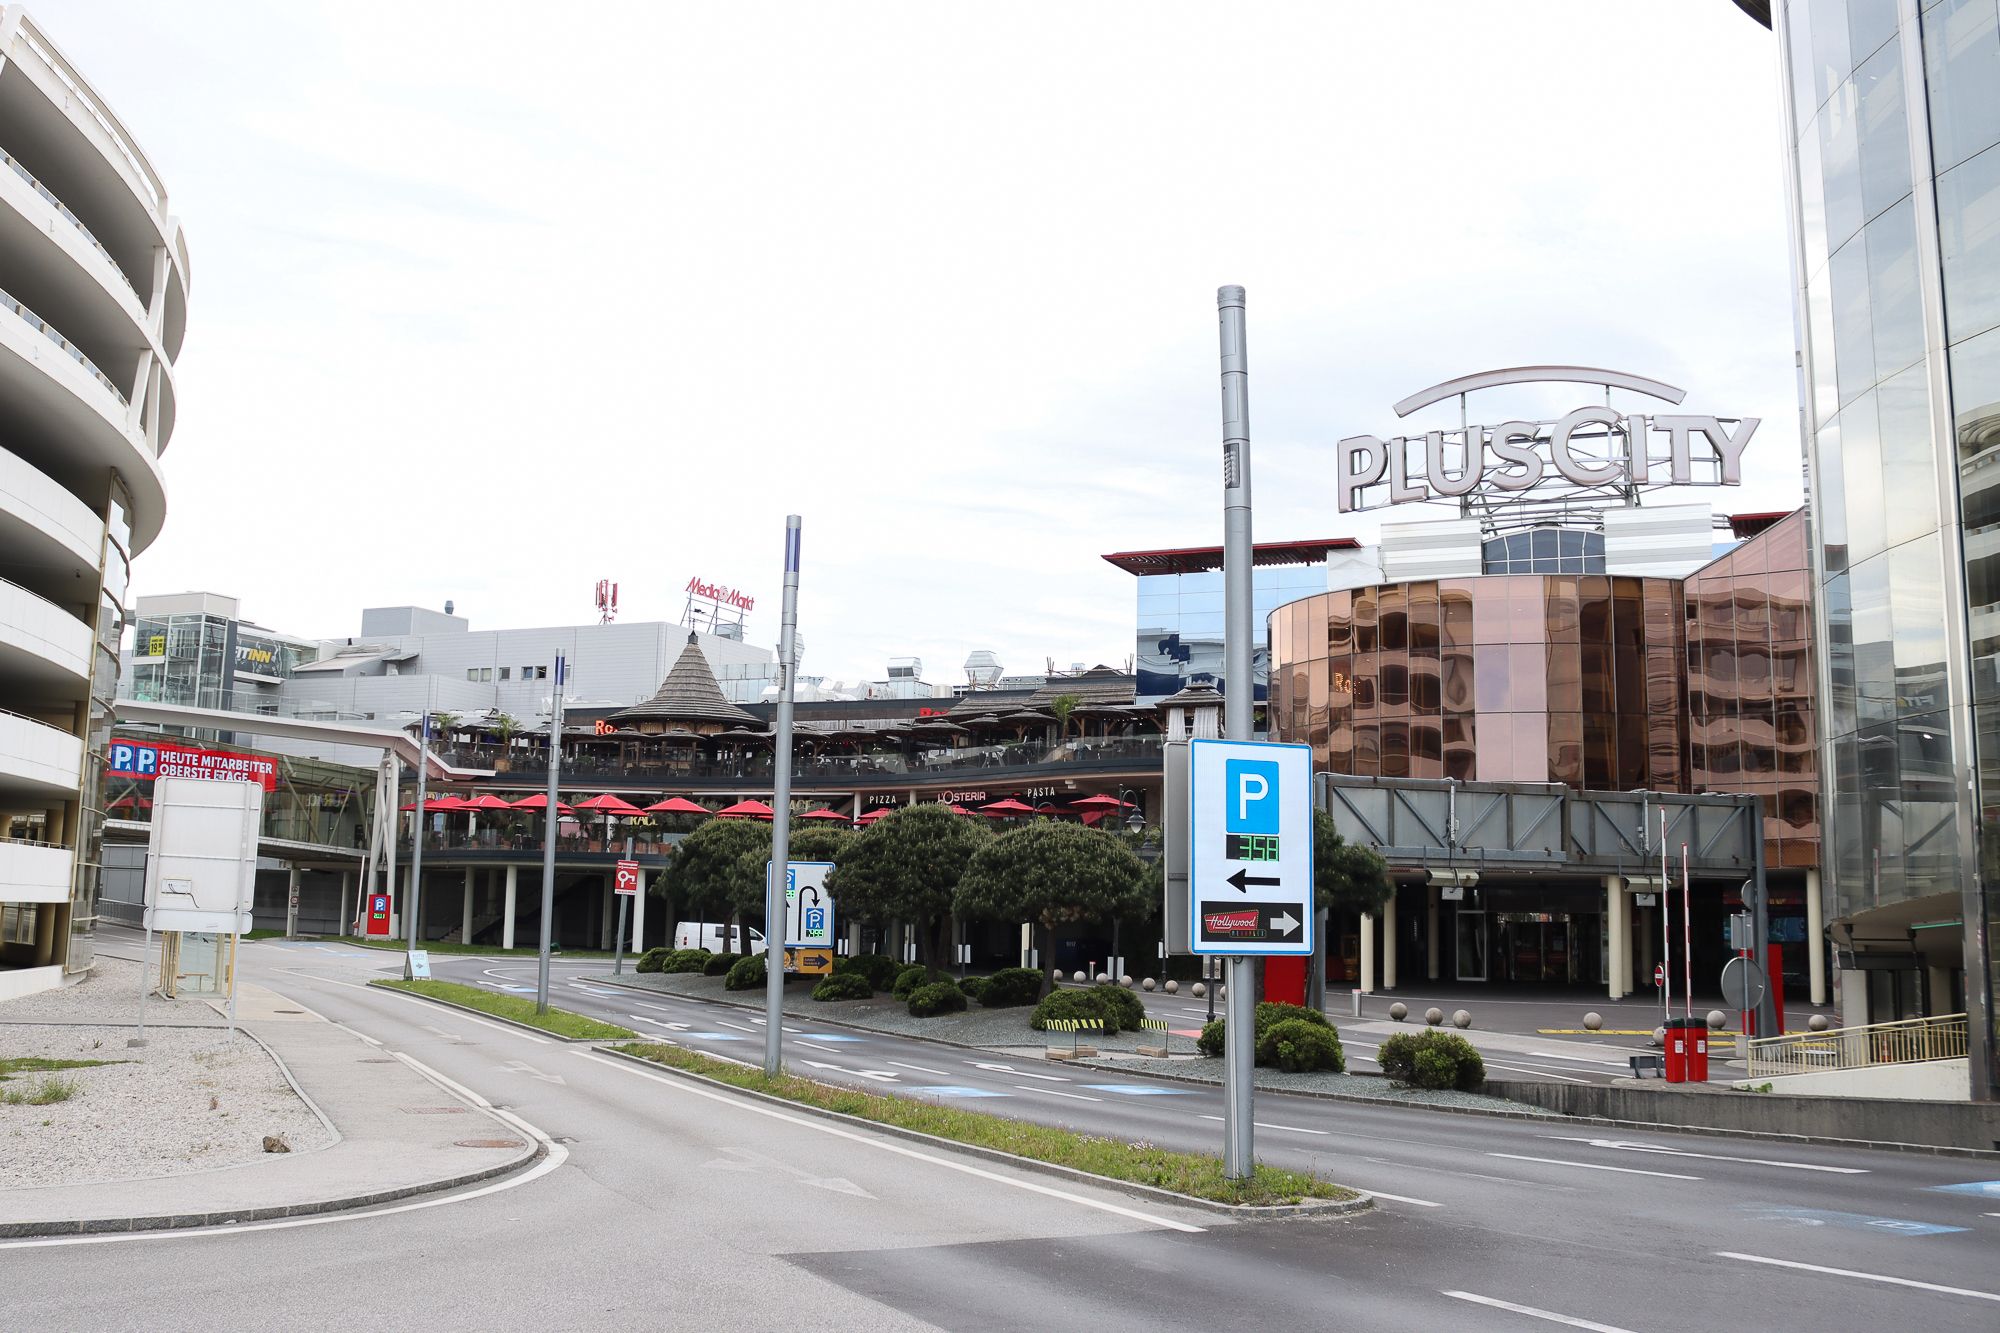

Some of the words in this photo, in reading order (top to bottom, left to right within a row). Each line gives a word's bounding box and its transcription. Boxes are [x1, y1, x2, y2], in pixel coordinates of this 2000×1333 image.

[160, 751, 198, 765] HEUTE
[201, 755, 272, 774] MITARBEITER
[159, 763, 211, 780] OBERSTE
[214, 770, 249, 782] ETAGE
[869, 795, 897, 804] PIZZA
[1027, 786, 1055, 798] PASTA
[1239, 772, 1269, 820] P
[1239, 835, 1279, 861] 358
[1205, 915, 1257, 929] Hollywood
